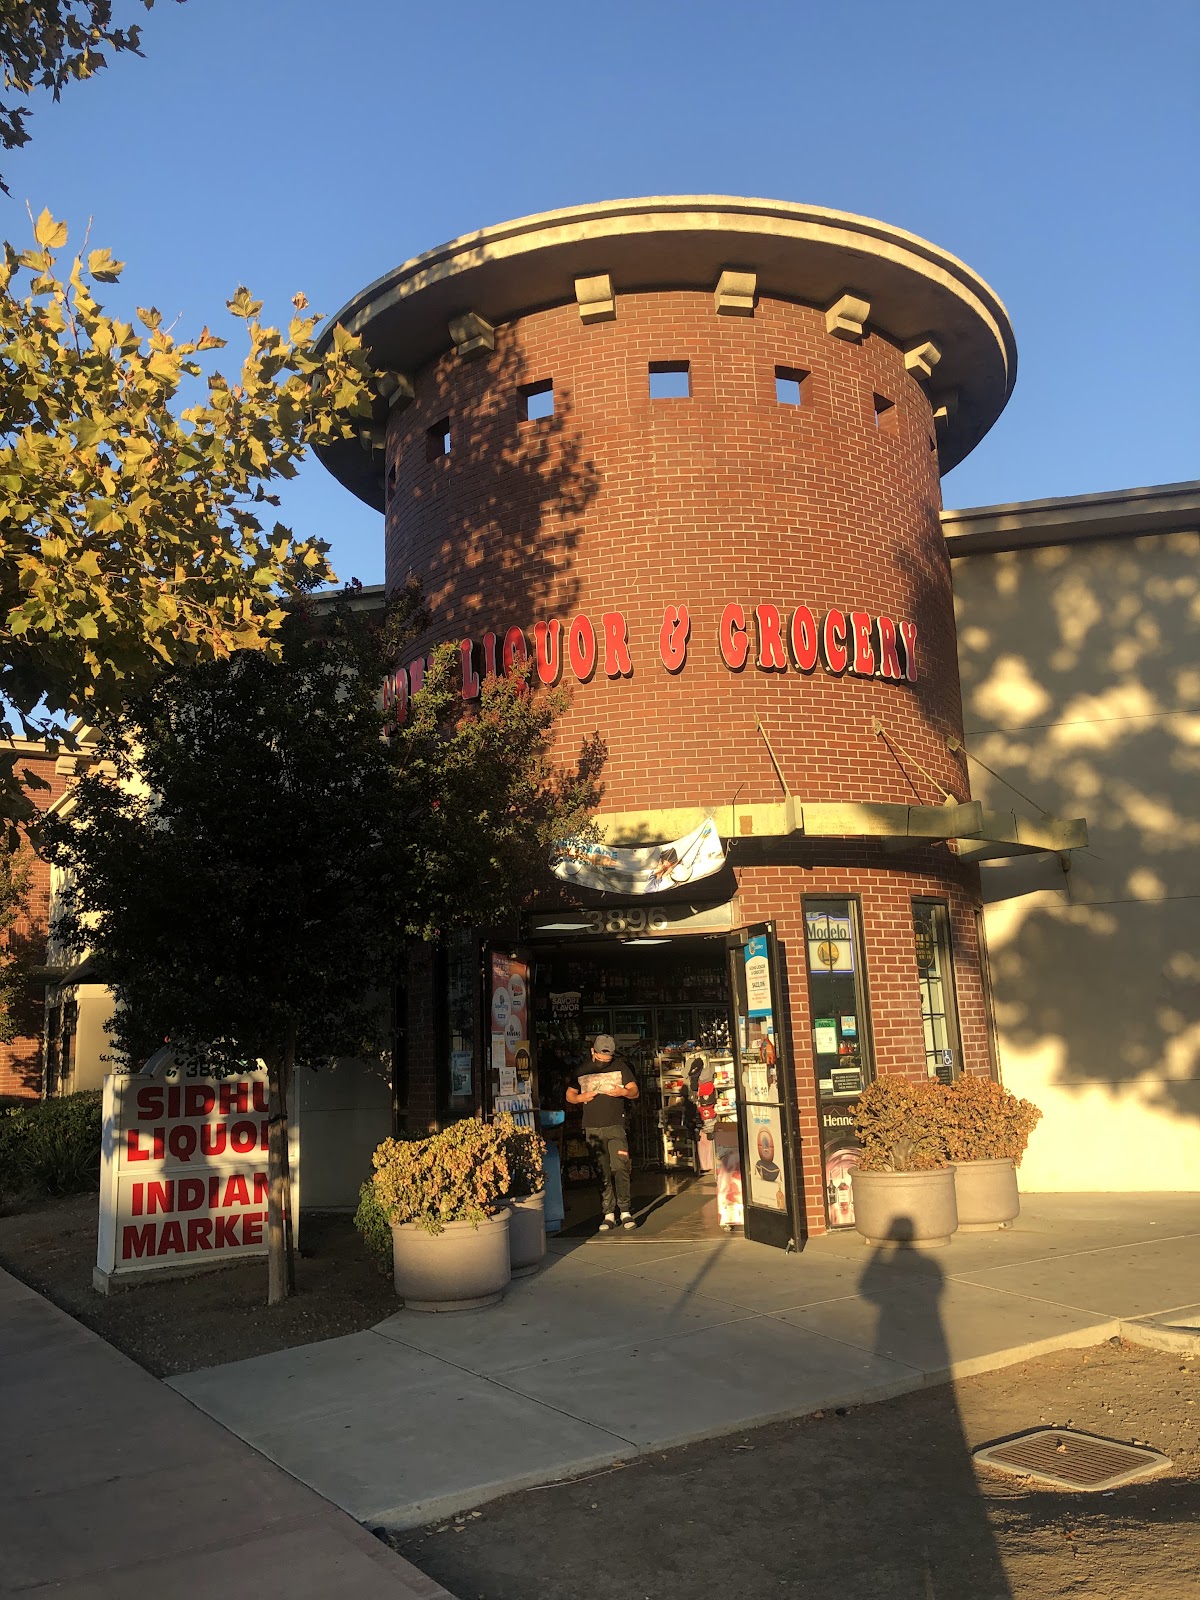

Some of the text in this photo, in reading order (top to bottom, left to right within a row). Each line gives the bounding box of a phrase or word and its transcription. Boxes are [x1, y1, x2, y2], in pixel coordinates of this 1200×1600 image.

[458, 611, 632, 701] LIQUOR
[659, 605, 690, 672] &
[719, 602, 917, 682] GROCERY
[586, 907, 668, 935] 3896
[807, 922, 847, 940] Modelo
